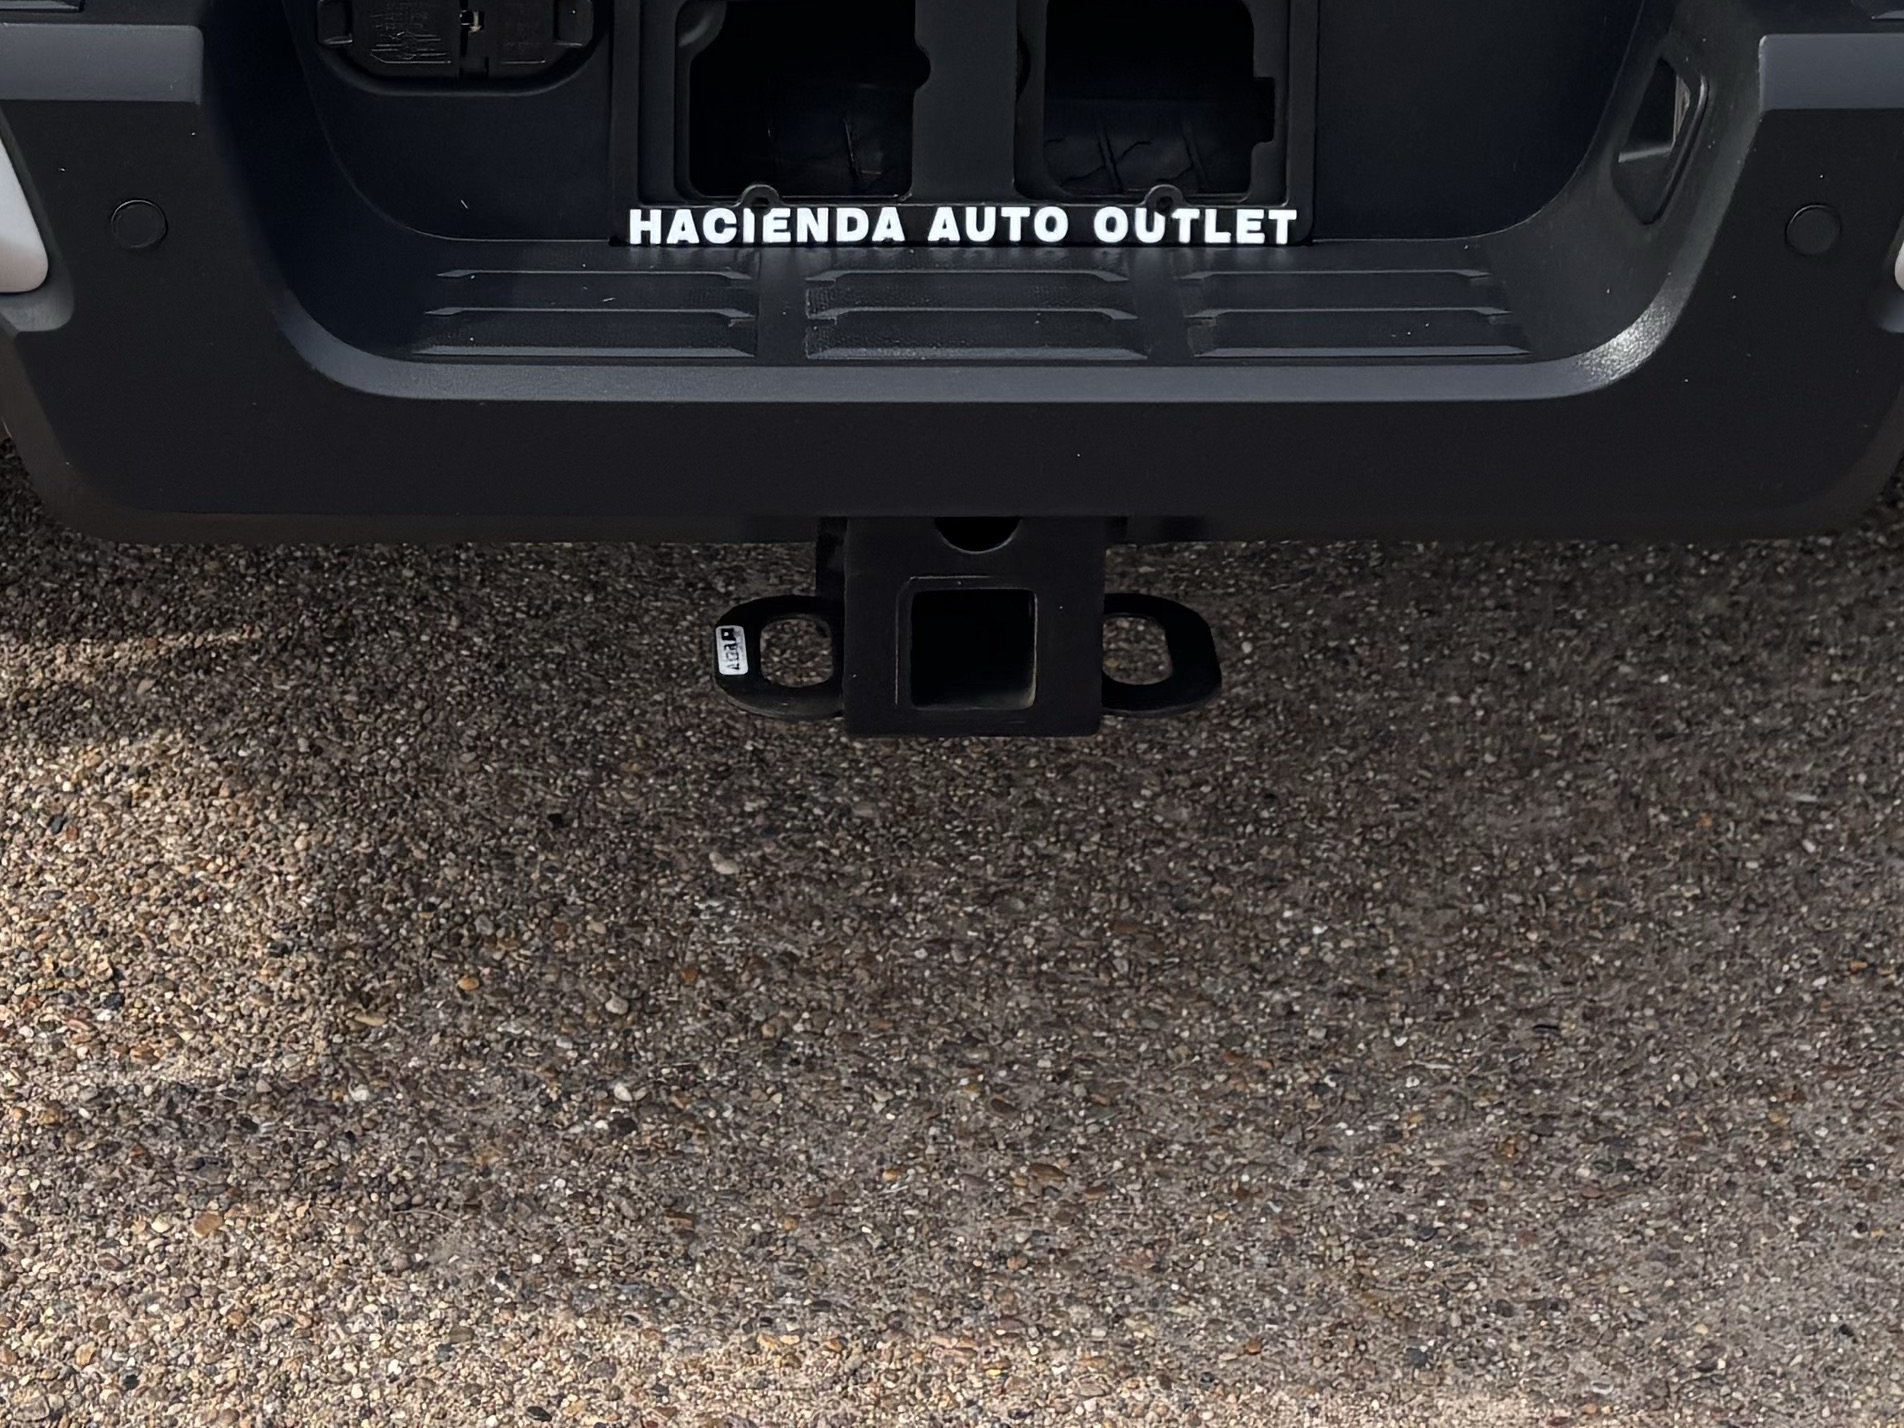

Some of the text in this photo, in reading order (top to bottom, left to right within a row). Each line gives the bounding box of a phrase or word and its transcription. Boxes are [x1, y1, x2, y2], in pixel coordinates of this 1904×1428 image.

[628, 208, 1298, 245] HACIENDA AUTO OUTLET
